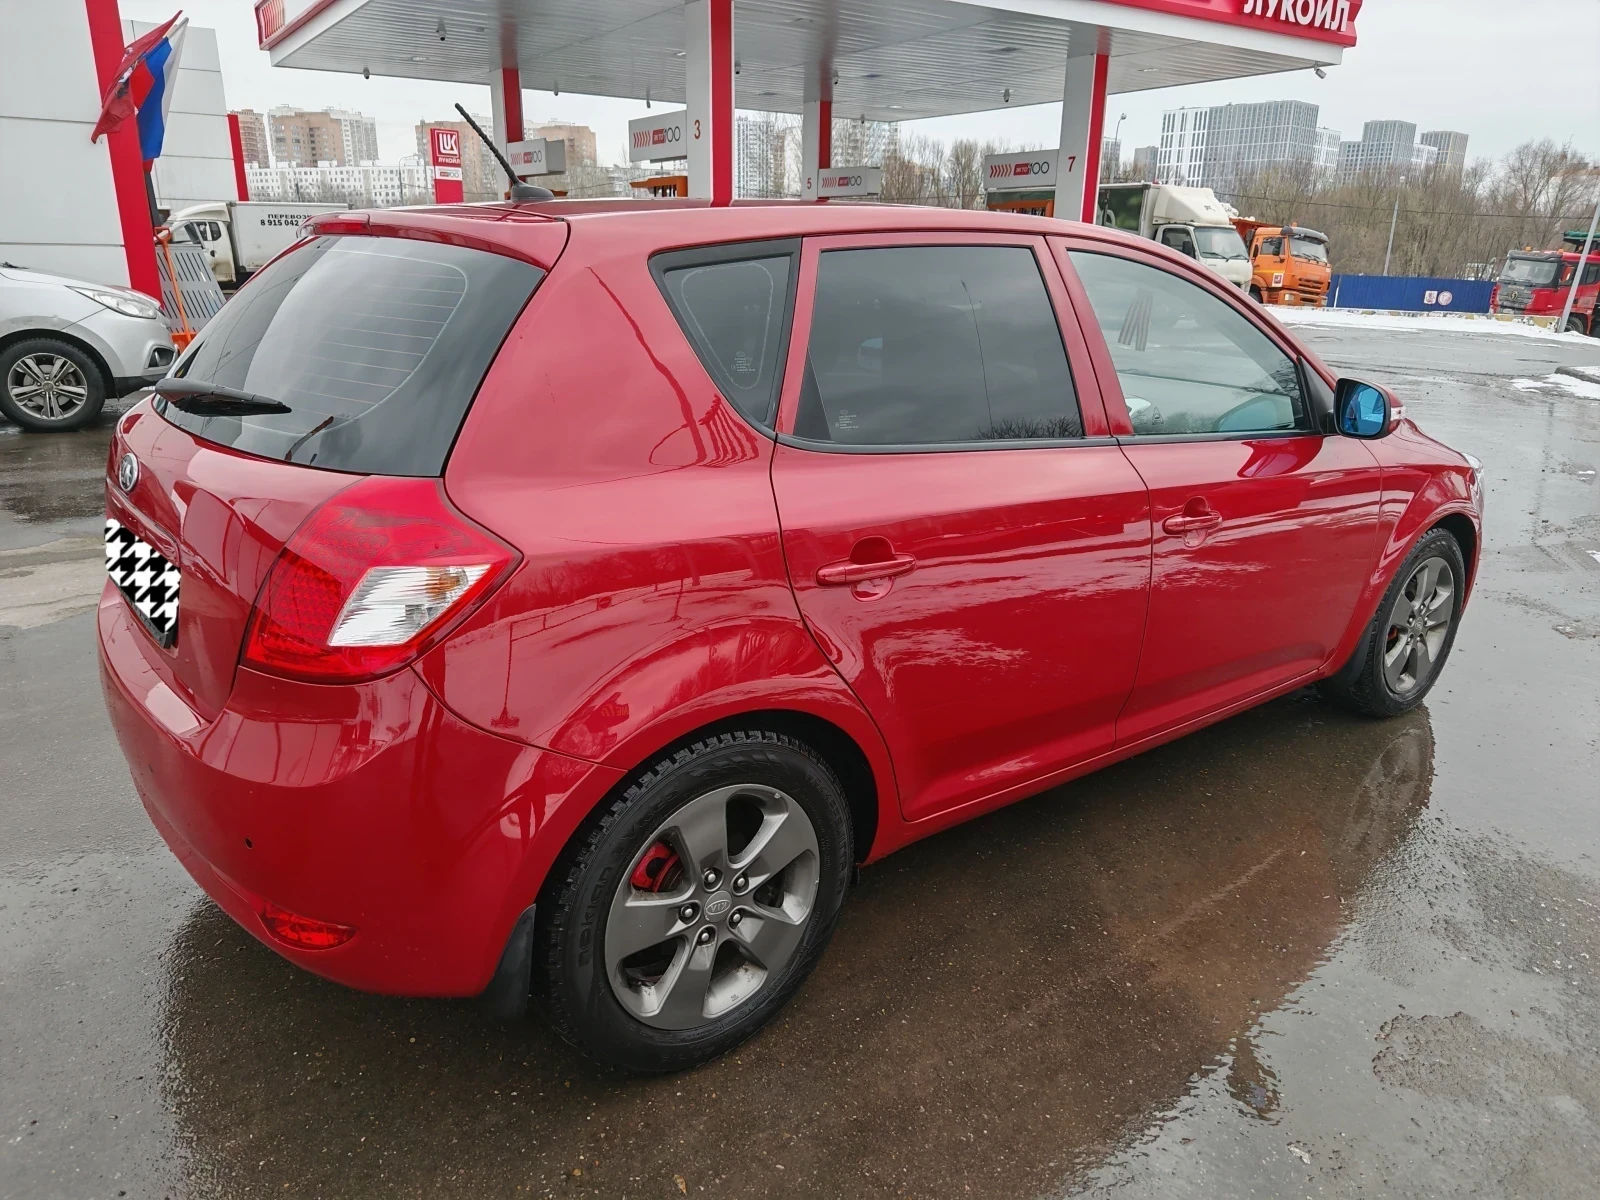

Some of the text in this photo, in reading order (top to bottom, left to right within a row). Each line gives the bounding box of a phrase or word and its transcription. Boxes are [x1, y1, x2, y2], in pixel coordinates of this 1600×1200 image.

[694, 119, 701, 140] 3
[1068, 156, 1076, 172] 7
[807, 177, 812, 189] 5
